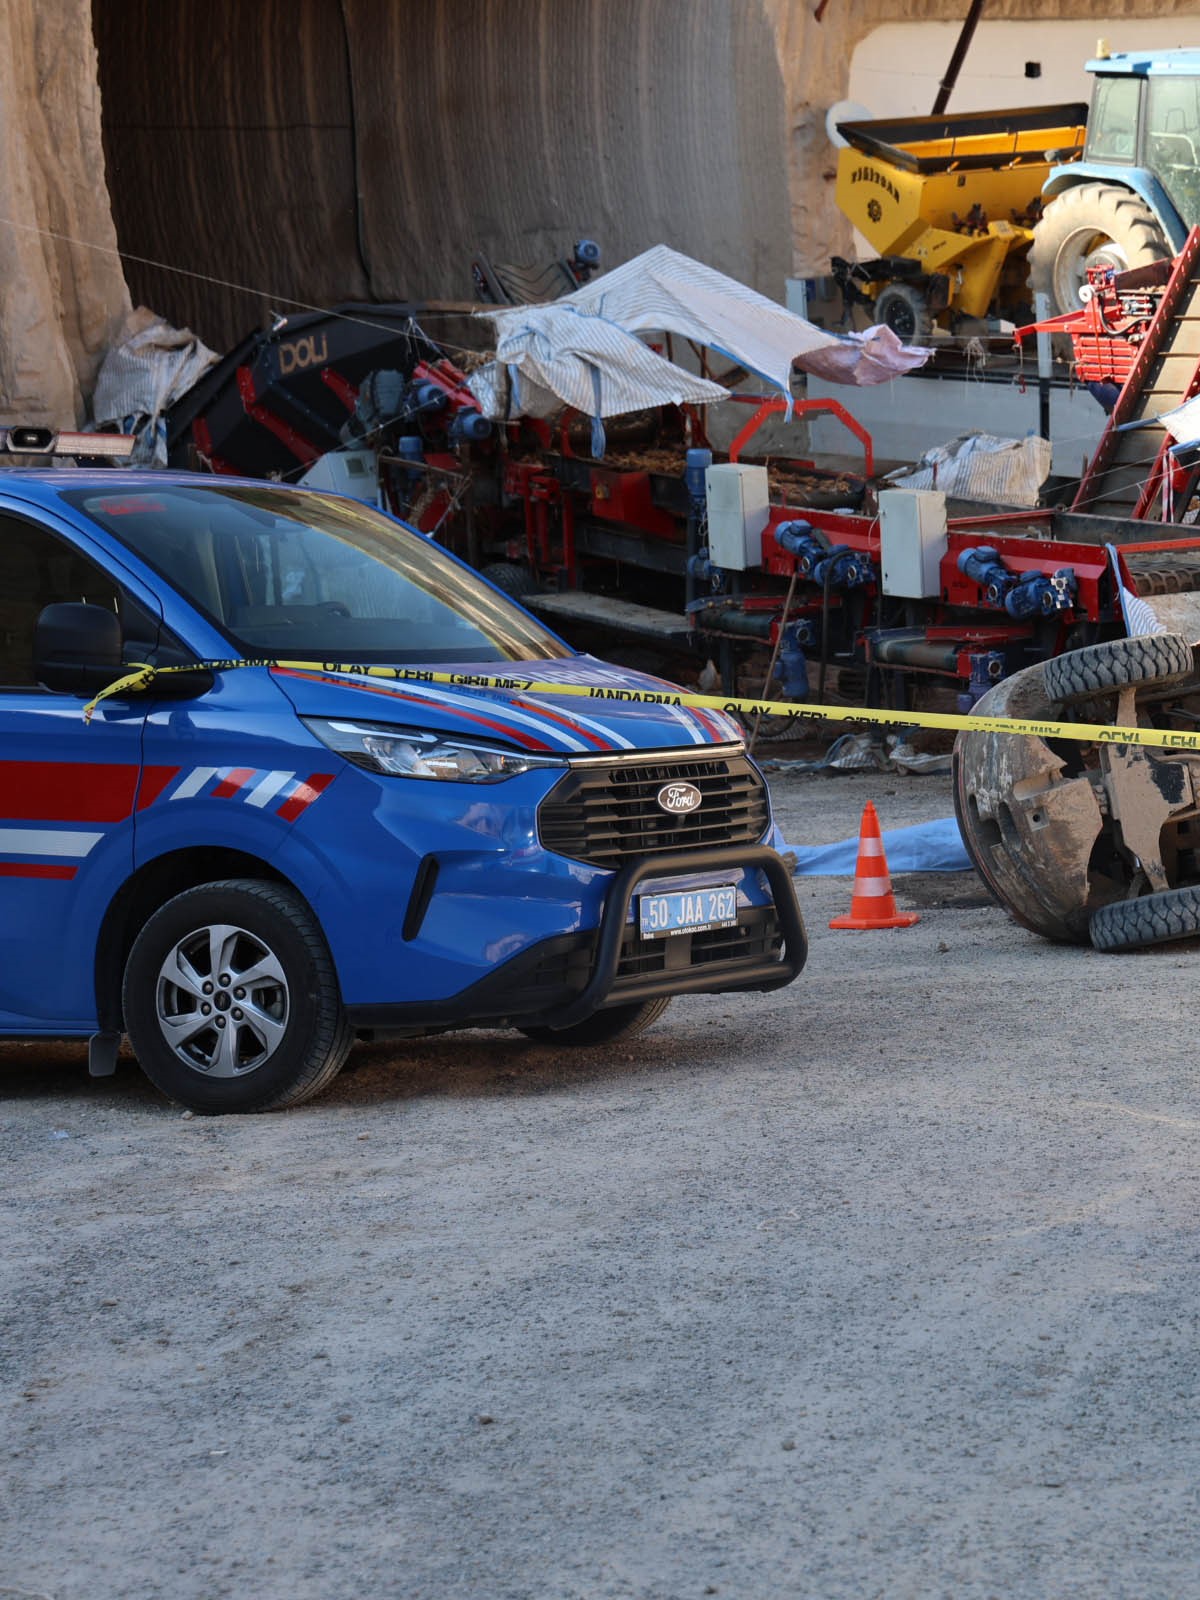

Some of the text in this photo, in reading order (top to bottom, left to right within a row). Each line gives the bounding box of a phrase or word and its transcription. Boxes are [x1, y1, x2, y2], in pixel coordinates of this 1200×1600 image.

[322, 662, 371, 676] OLAY
[667, 787, 695, 809] Ford
[649, 898, 669, 929] 50
[676, 895, 704, 925] JAA
[708, 891, 734, 921] 262
